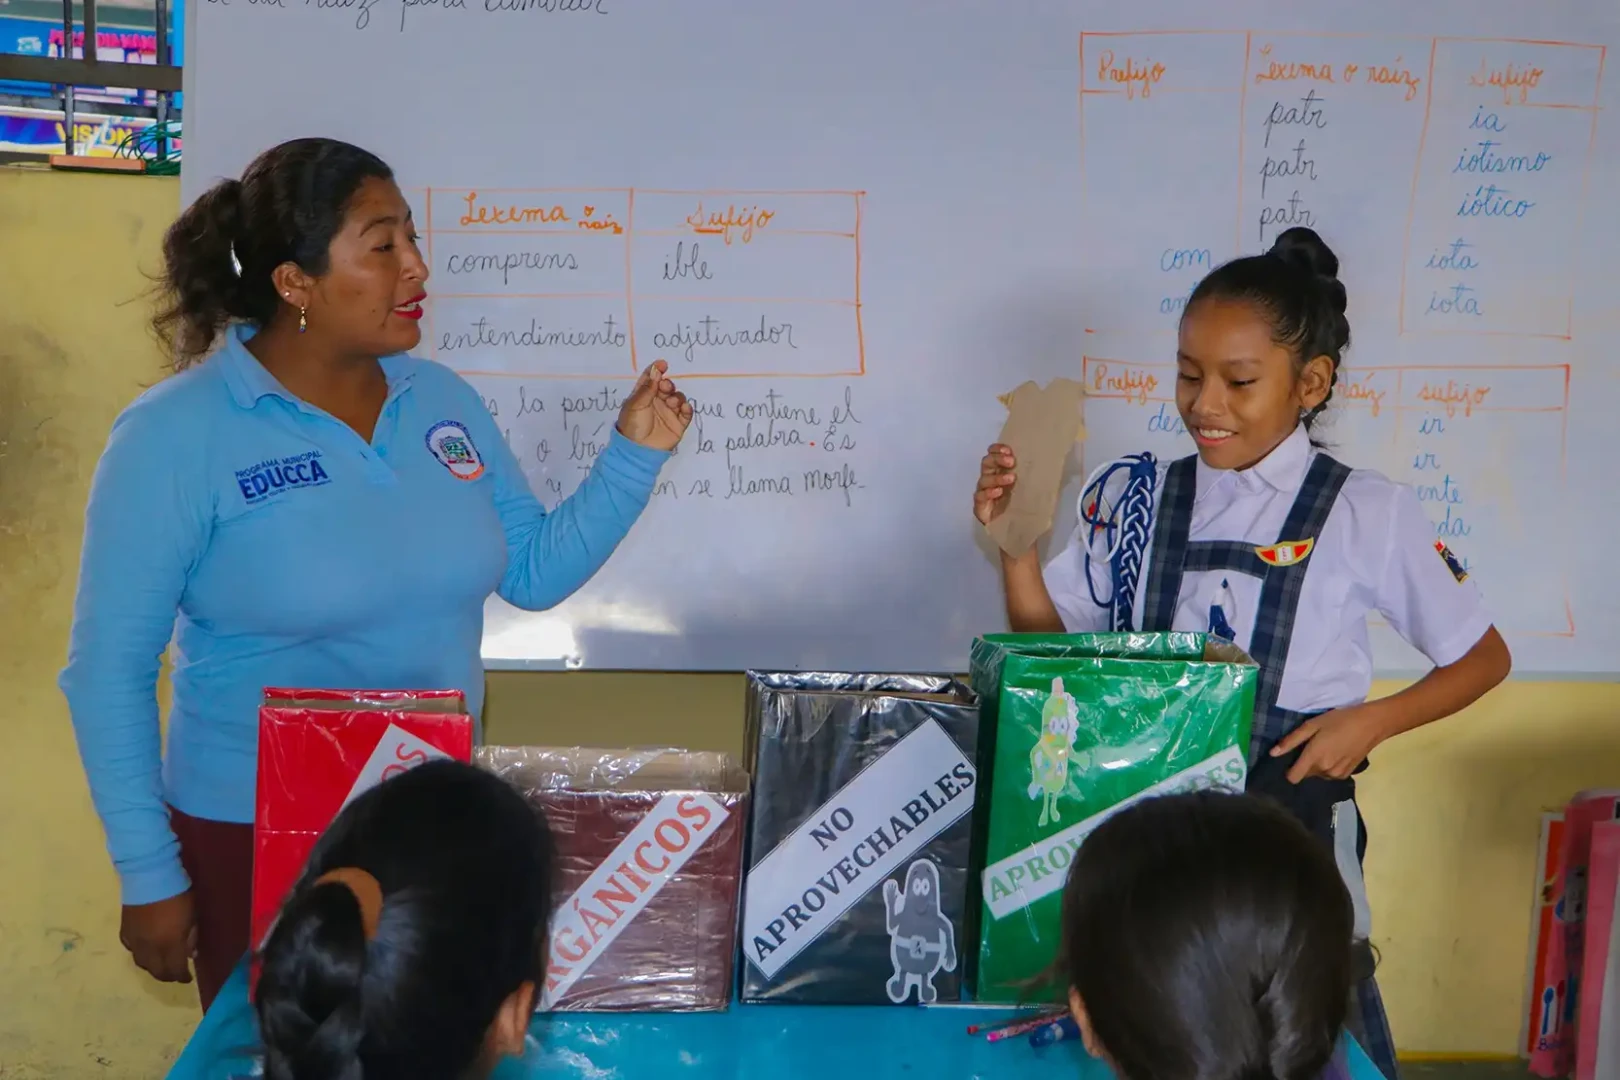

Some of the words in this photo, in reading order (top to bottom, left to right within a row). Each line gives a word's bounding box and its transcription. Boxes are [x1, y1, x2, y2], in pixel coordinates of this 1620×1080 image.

[1098, 49, 1165, 100] Prefijo
[1344, 64, 1358, 83] o
[56, 122, 133, 147] VISON
[1263, 89, 1327, 148] patr
[1468, 105, 1508, 132] ia
[1259, 138, 1318, 200] patr
[1452, 140, 1551, 173] iotismo
[460, 192, 572, 226] Lexema
[1259, 190, 1316, 242] patr
[1457, 184, 1537, 217] iótico
[680, 201, 776, 246] Sufijo
[447, 251, 579, 286] comprens
[662, 241, 714, 281] ible
[1160, 248, 1212, 272] com
[1424, 238, 1479, 270] iota
[1424, 282, 1483, 316] iota
[437, 314, 627, 352] entendimiento
[653, 314, 798, 363] adjetivador
[516, 386, 546, 418] la
[560, 386, 626, 430] partí
[736, 388, 821, 426] contiene
[830, 385, 862, 424] el
[1419, 410, 1445, 435] ir
[696, 424, 715, 455] la
[238, 459, 329, 500] EDUCCA
[688, 479, 713, 498] se
[724, 465, 794, 500] llama
[1430, 504, 1472, 537] da
[808, 806, 855, 852] NO
[751, 762, 975, 963] APROVECHABLES
[546, 795, 713, 993] RGÁNICOS
